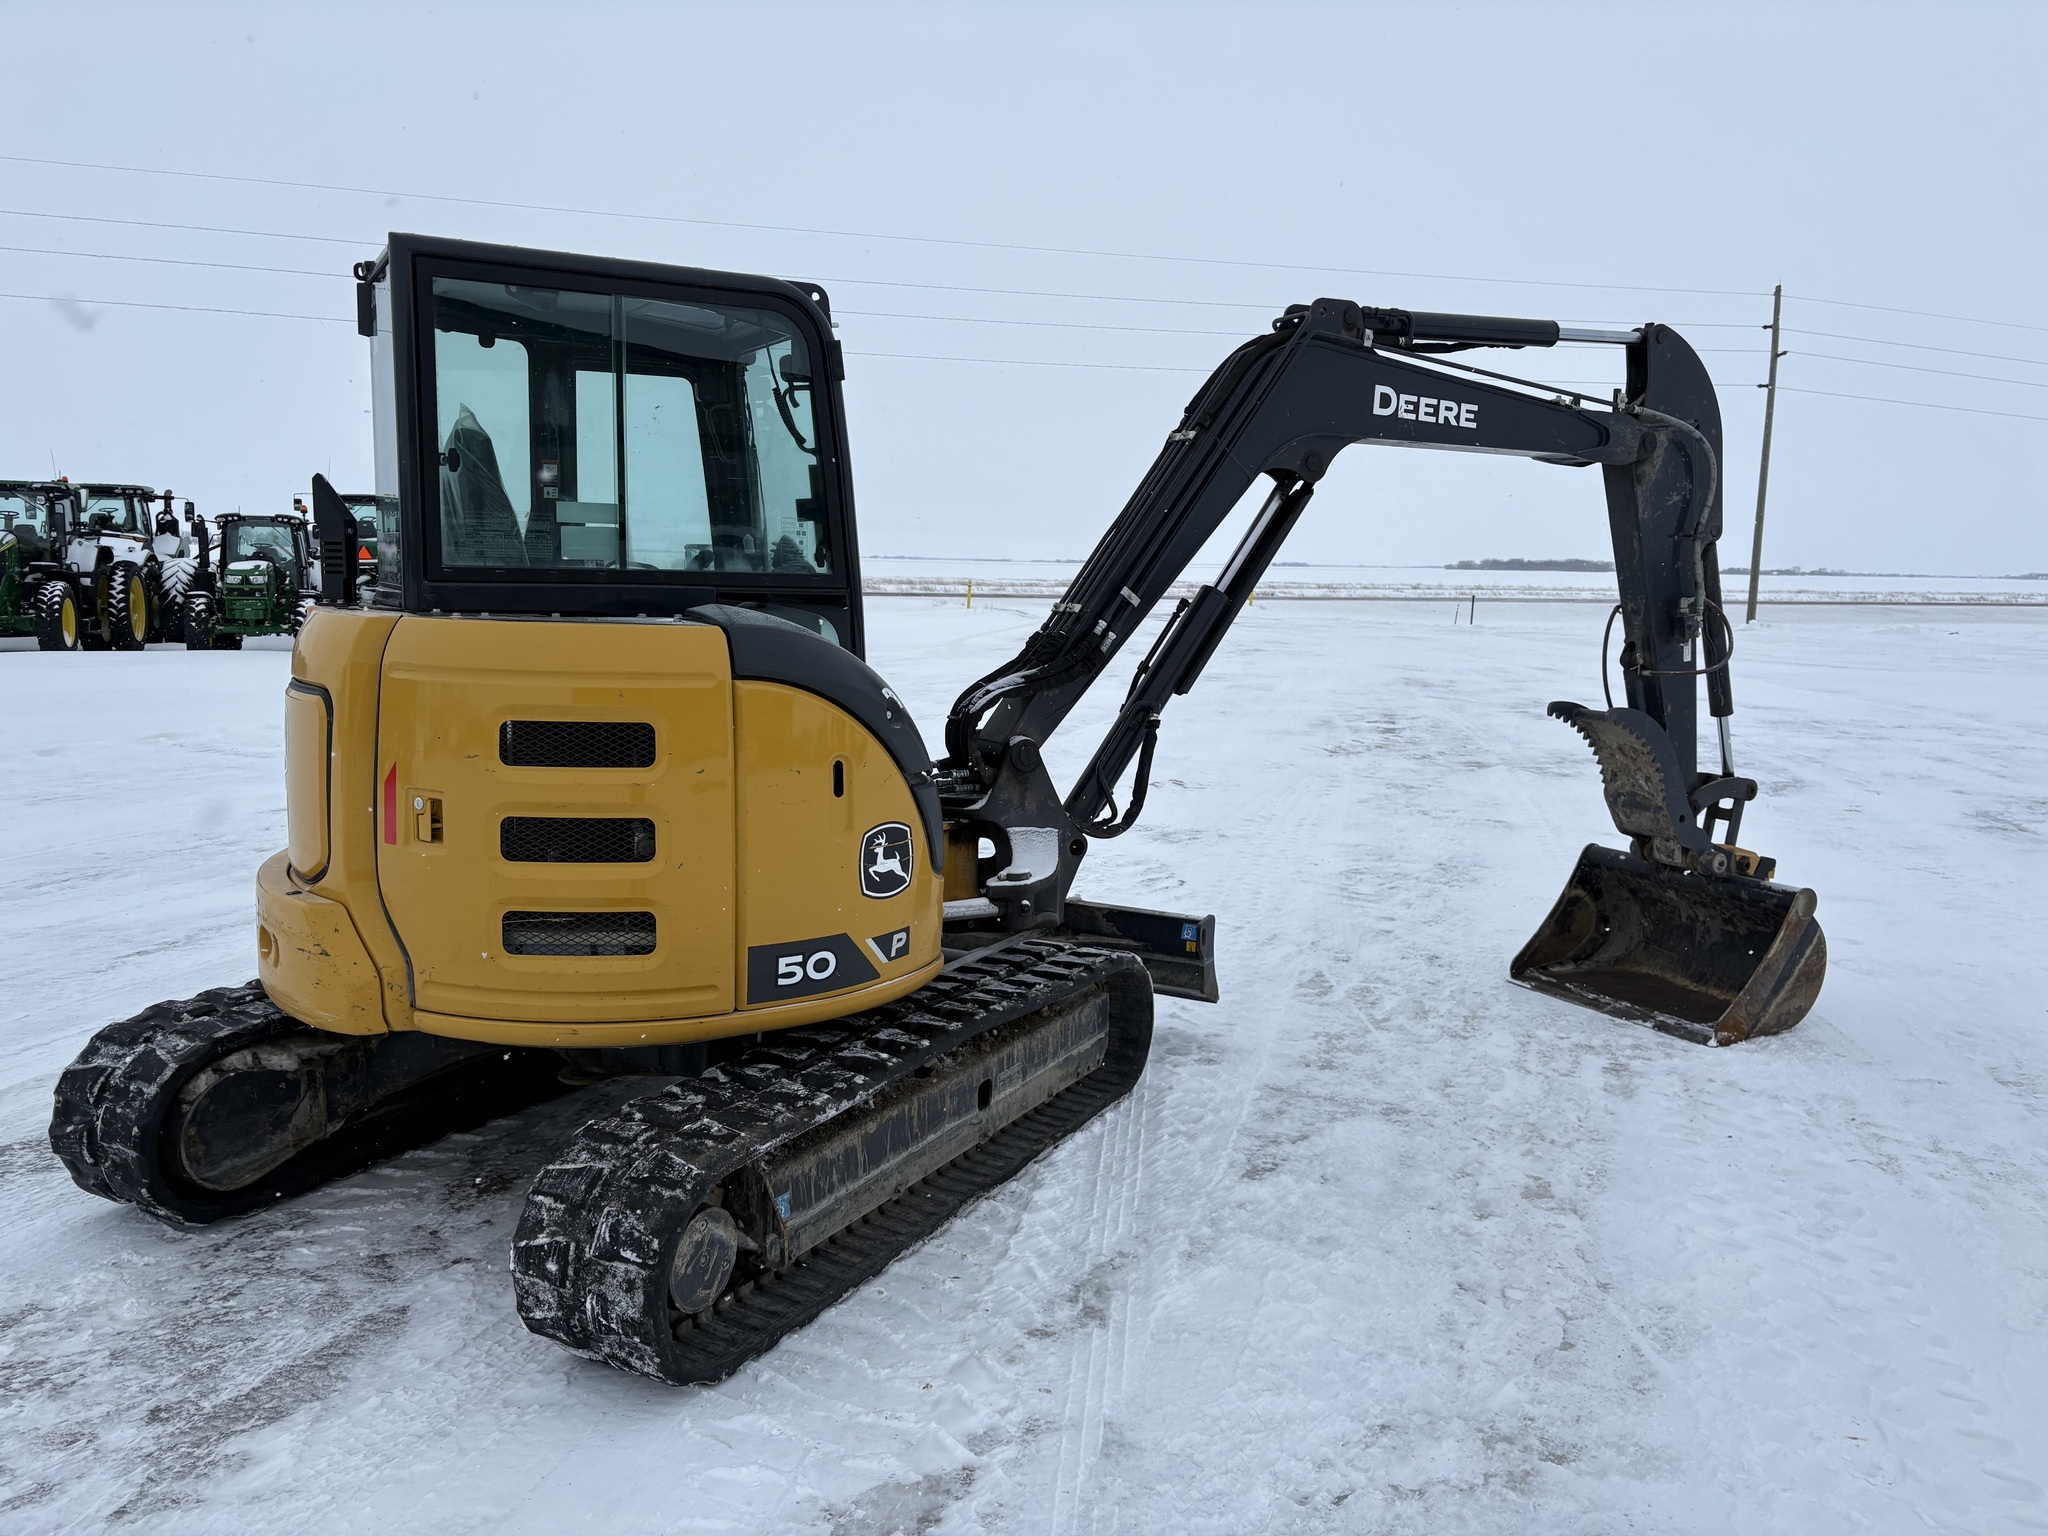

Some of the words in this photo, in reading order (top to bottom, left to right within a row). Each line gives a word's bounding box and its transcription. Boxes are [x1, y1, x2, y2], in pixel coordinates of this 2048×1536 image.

[1372, 384, 1479, 428] DEERE
[777, 950, 837, 986] 50
[890, 931, 907, 958] P
